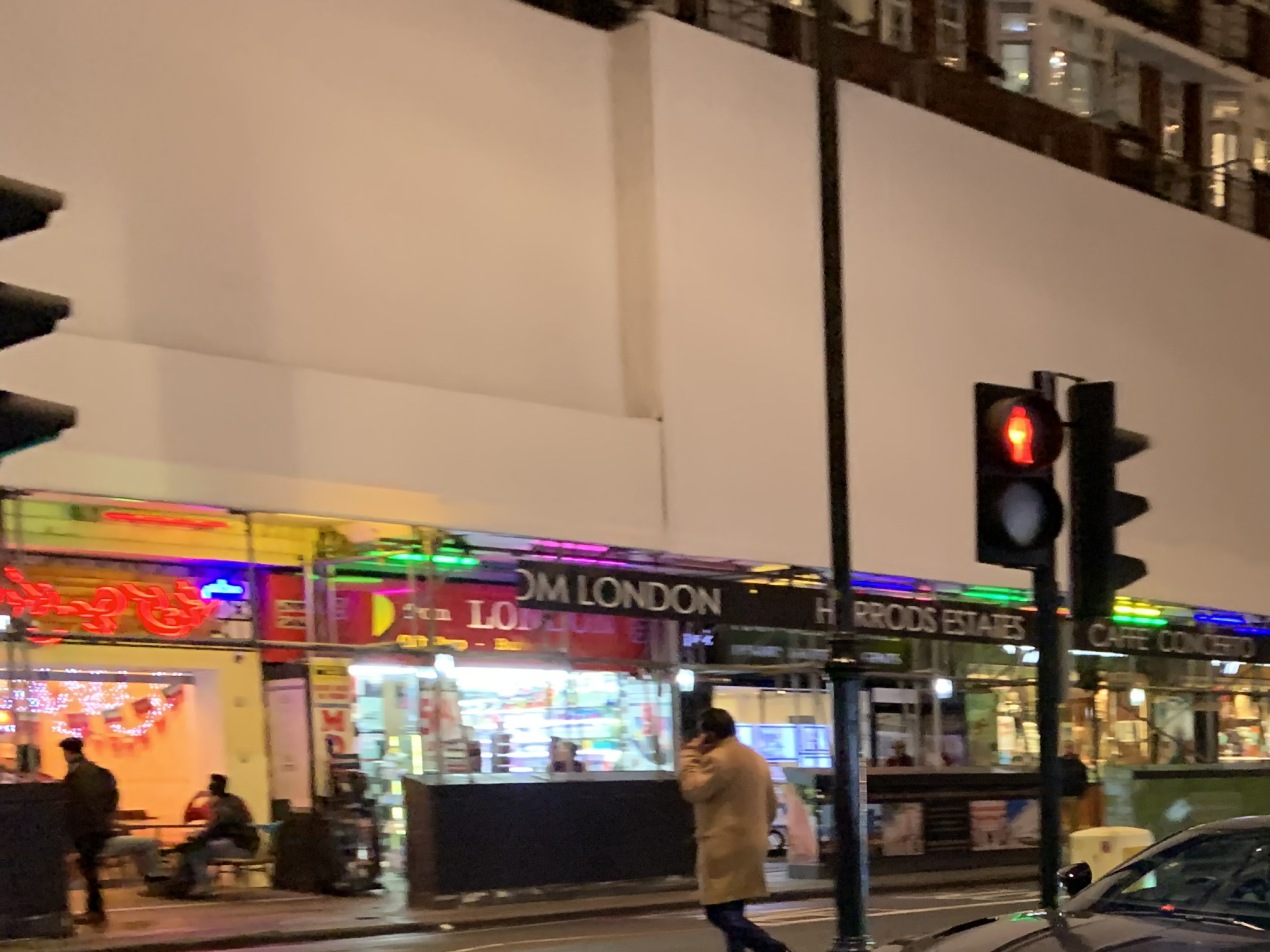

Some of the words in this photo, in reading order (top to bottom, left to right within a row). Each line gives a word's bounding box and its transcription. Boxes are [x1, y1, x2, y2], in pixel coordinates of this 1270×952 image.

[577, 575, 722, 616] LONDON
[815, 597, 937, 633] HRRODS
[942, 609, 1026, 641] ESTATES
